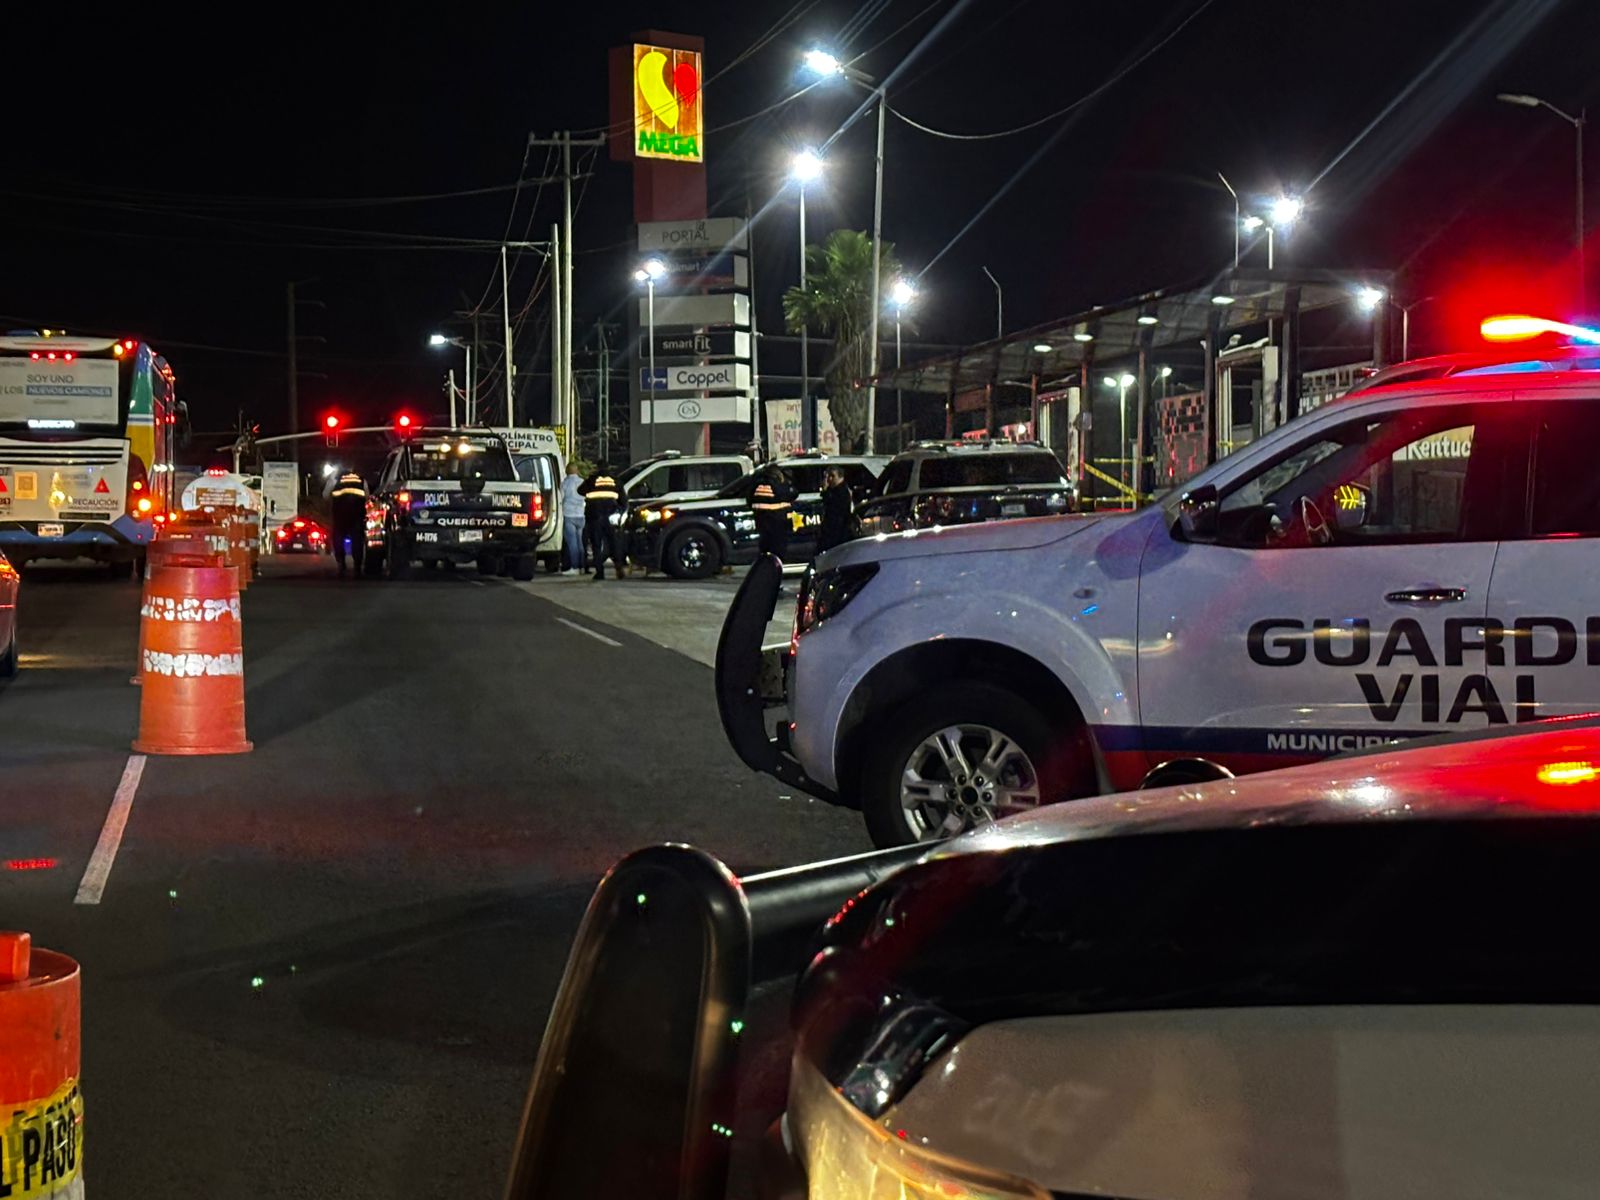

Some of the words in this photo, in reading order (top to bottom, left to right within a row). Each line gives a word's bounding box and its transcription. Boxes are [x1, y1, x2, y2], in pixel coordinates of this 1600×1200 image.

[638, 131, 700, 157] MEGA
[661, 229, 710, 243] PORTAL
[662, 339, 693, 350] smart
[26, 374, 48, 384] SOY
[50, 374, 74, 384] UNO
[676, 368, 731, 388] Coppel
[4, 385, 24, 395] LOS
[496, 430, 554, 443] OLÍMETRO
[424, 491, 450, 506] POLICÍA
[491, 493, 523, 508] MUNICIPAL
[437, 517, 507, 527] QUERÉTARO
[1355, 673, 1546, 725] VIAL
[22, 1107, 77, 1192] PASO
